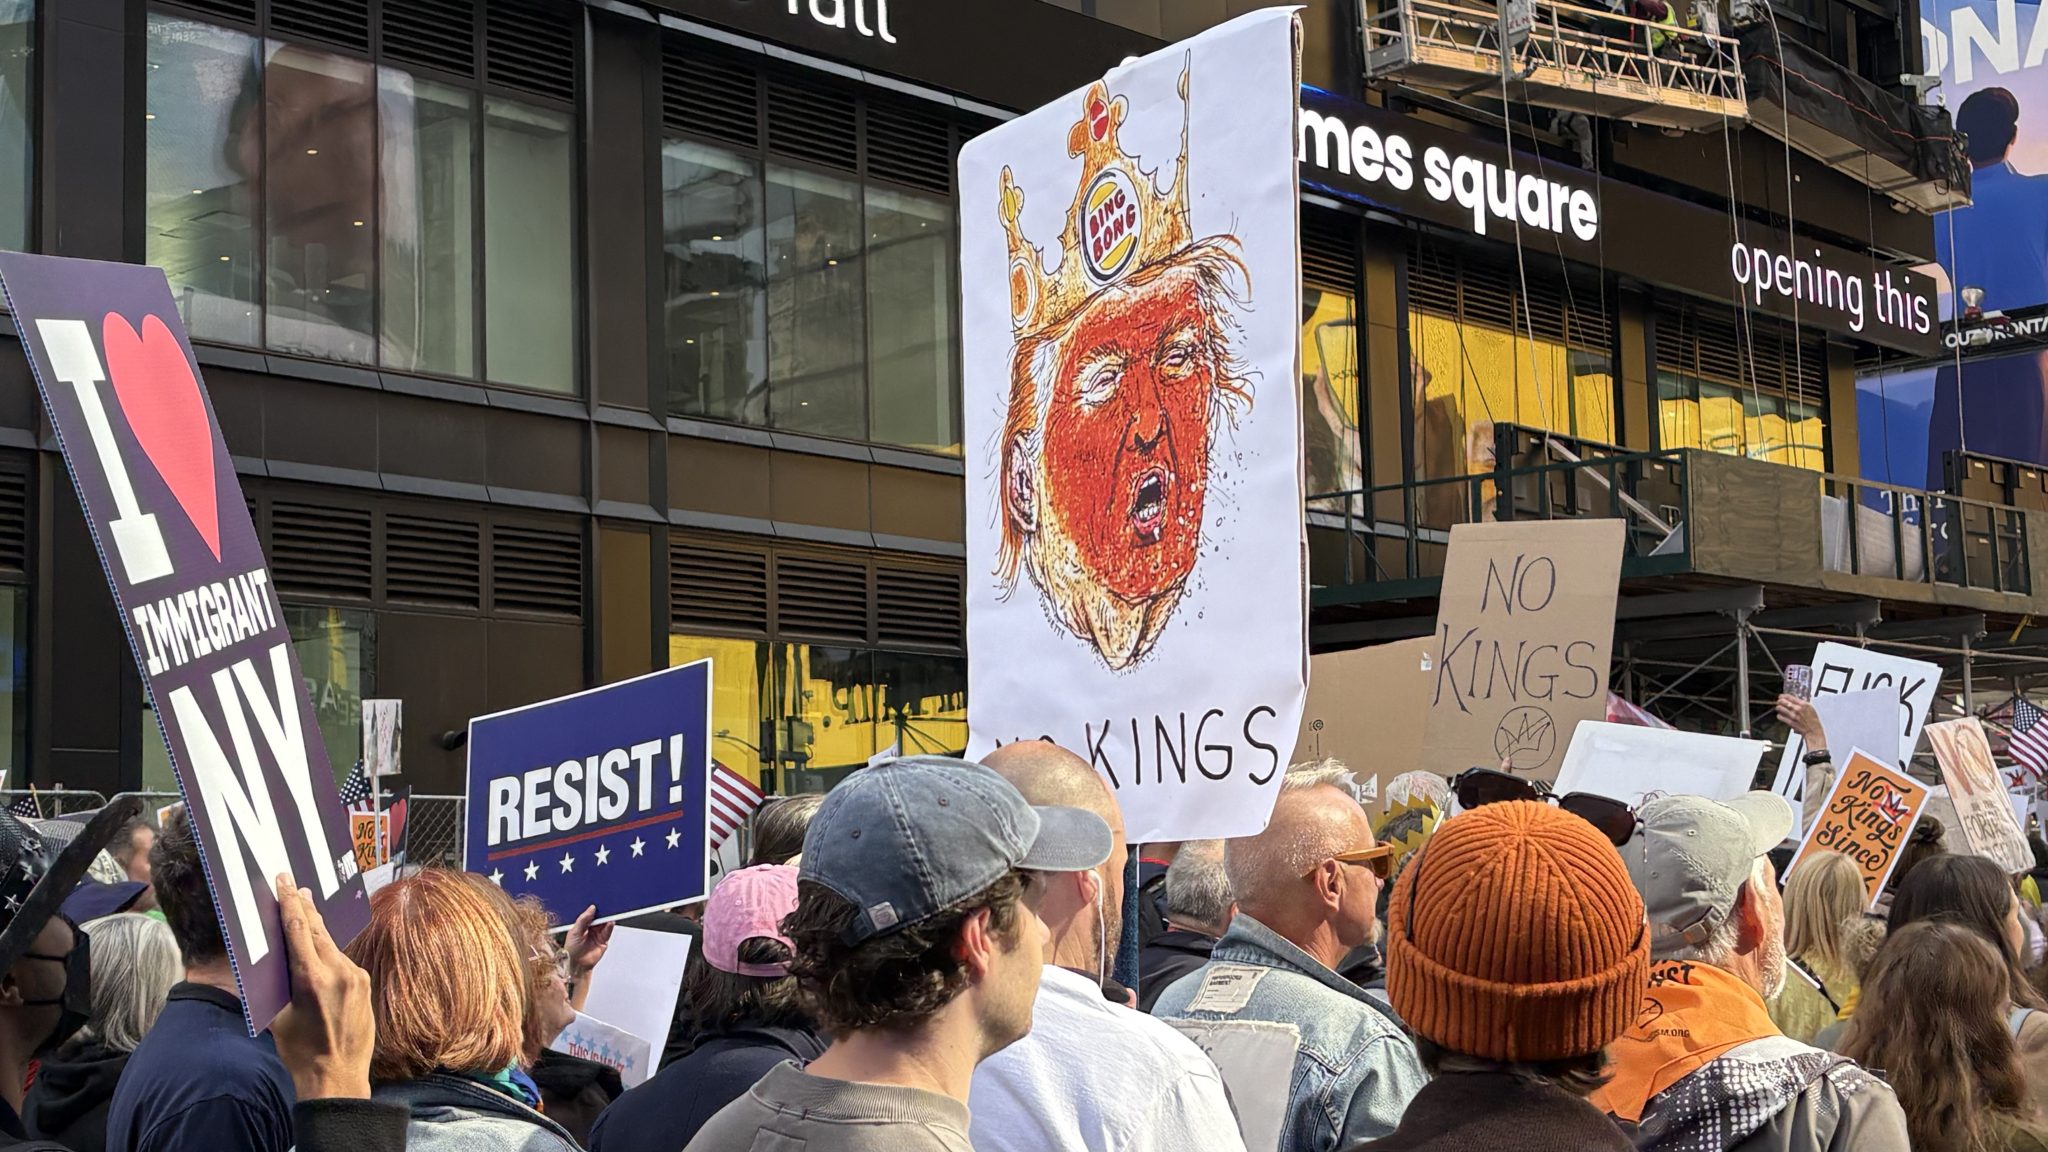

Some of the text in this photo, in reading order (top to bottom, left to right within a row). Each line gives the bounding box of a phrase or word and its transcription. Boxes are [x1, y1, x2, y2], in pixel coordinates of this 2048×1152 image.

[1089, 188, 1125, 239] BING
[1093, 203, 1136, 263] BONG
[1424, 147, 1598, 241] square
[1732, 242, 1931, 334] opening this
[35, 319, 174, 585] I
[133, 568, 277, 676] IMMIGRANT
[1481, 554, 1556, 615] NO
[1433, 623, 1598, 715] KINGS
[487, 734, 684, 846] RESIST!
[1086, 705, 1279, 789] KINGS
[1848, 770, 1912, 799] No
[169, 643, 340, 965] NY
[1816, 820, 1889, 871] Since
[1831, 795, 1903, 850] Kings
